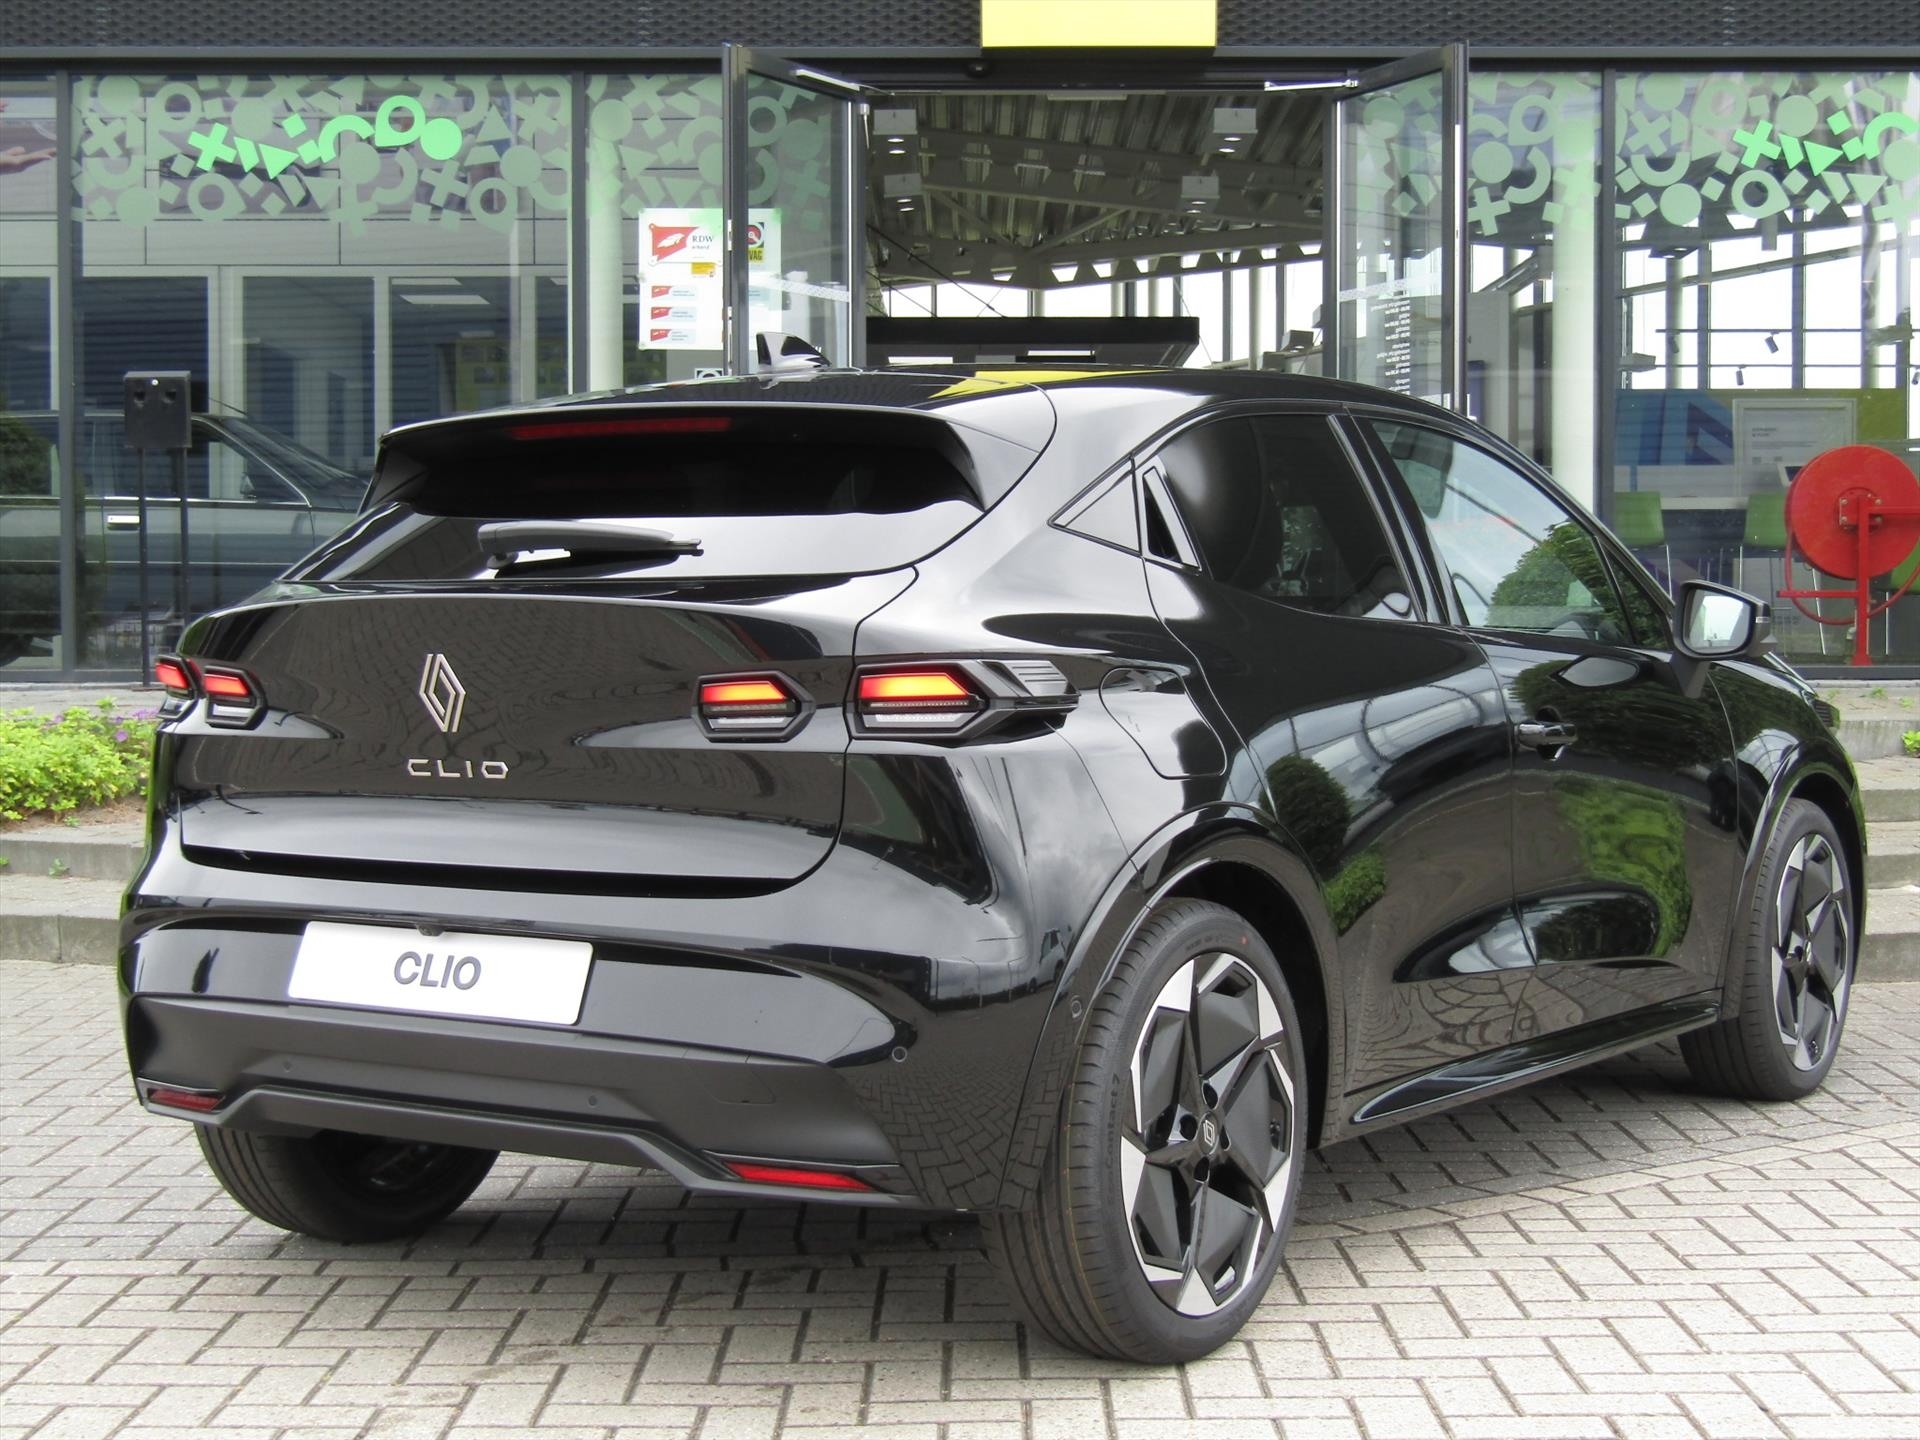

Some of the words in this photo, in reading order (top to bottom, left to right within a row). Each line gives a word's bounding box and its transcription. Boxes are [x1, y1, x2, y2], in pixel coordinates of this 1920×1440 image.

[692, 235, 713, 243] RDW
[407, 759, 509, 779] CLIO
[394, 951, 482, 990] CLIO
